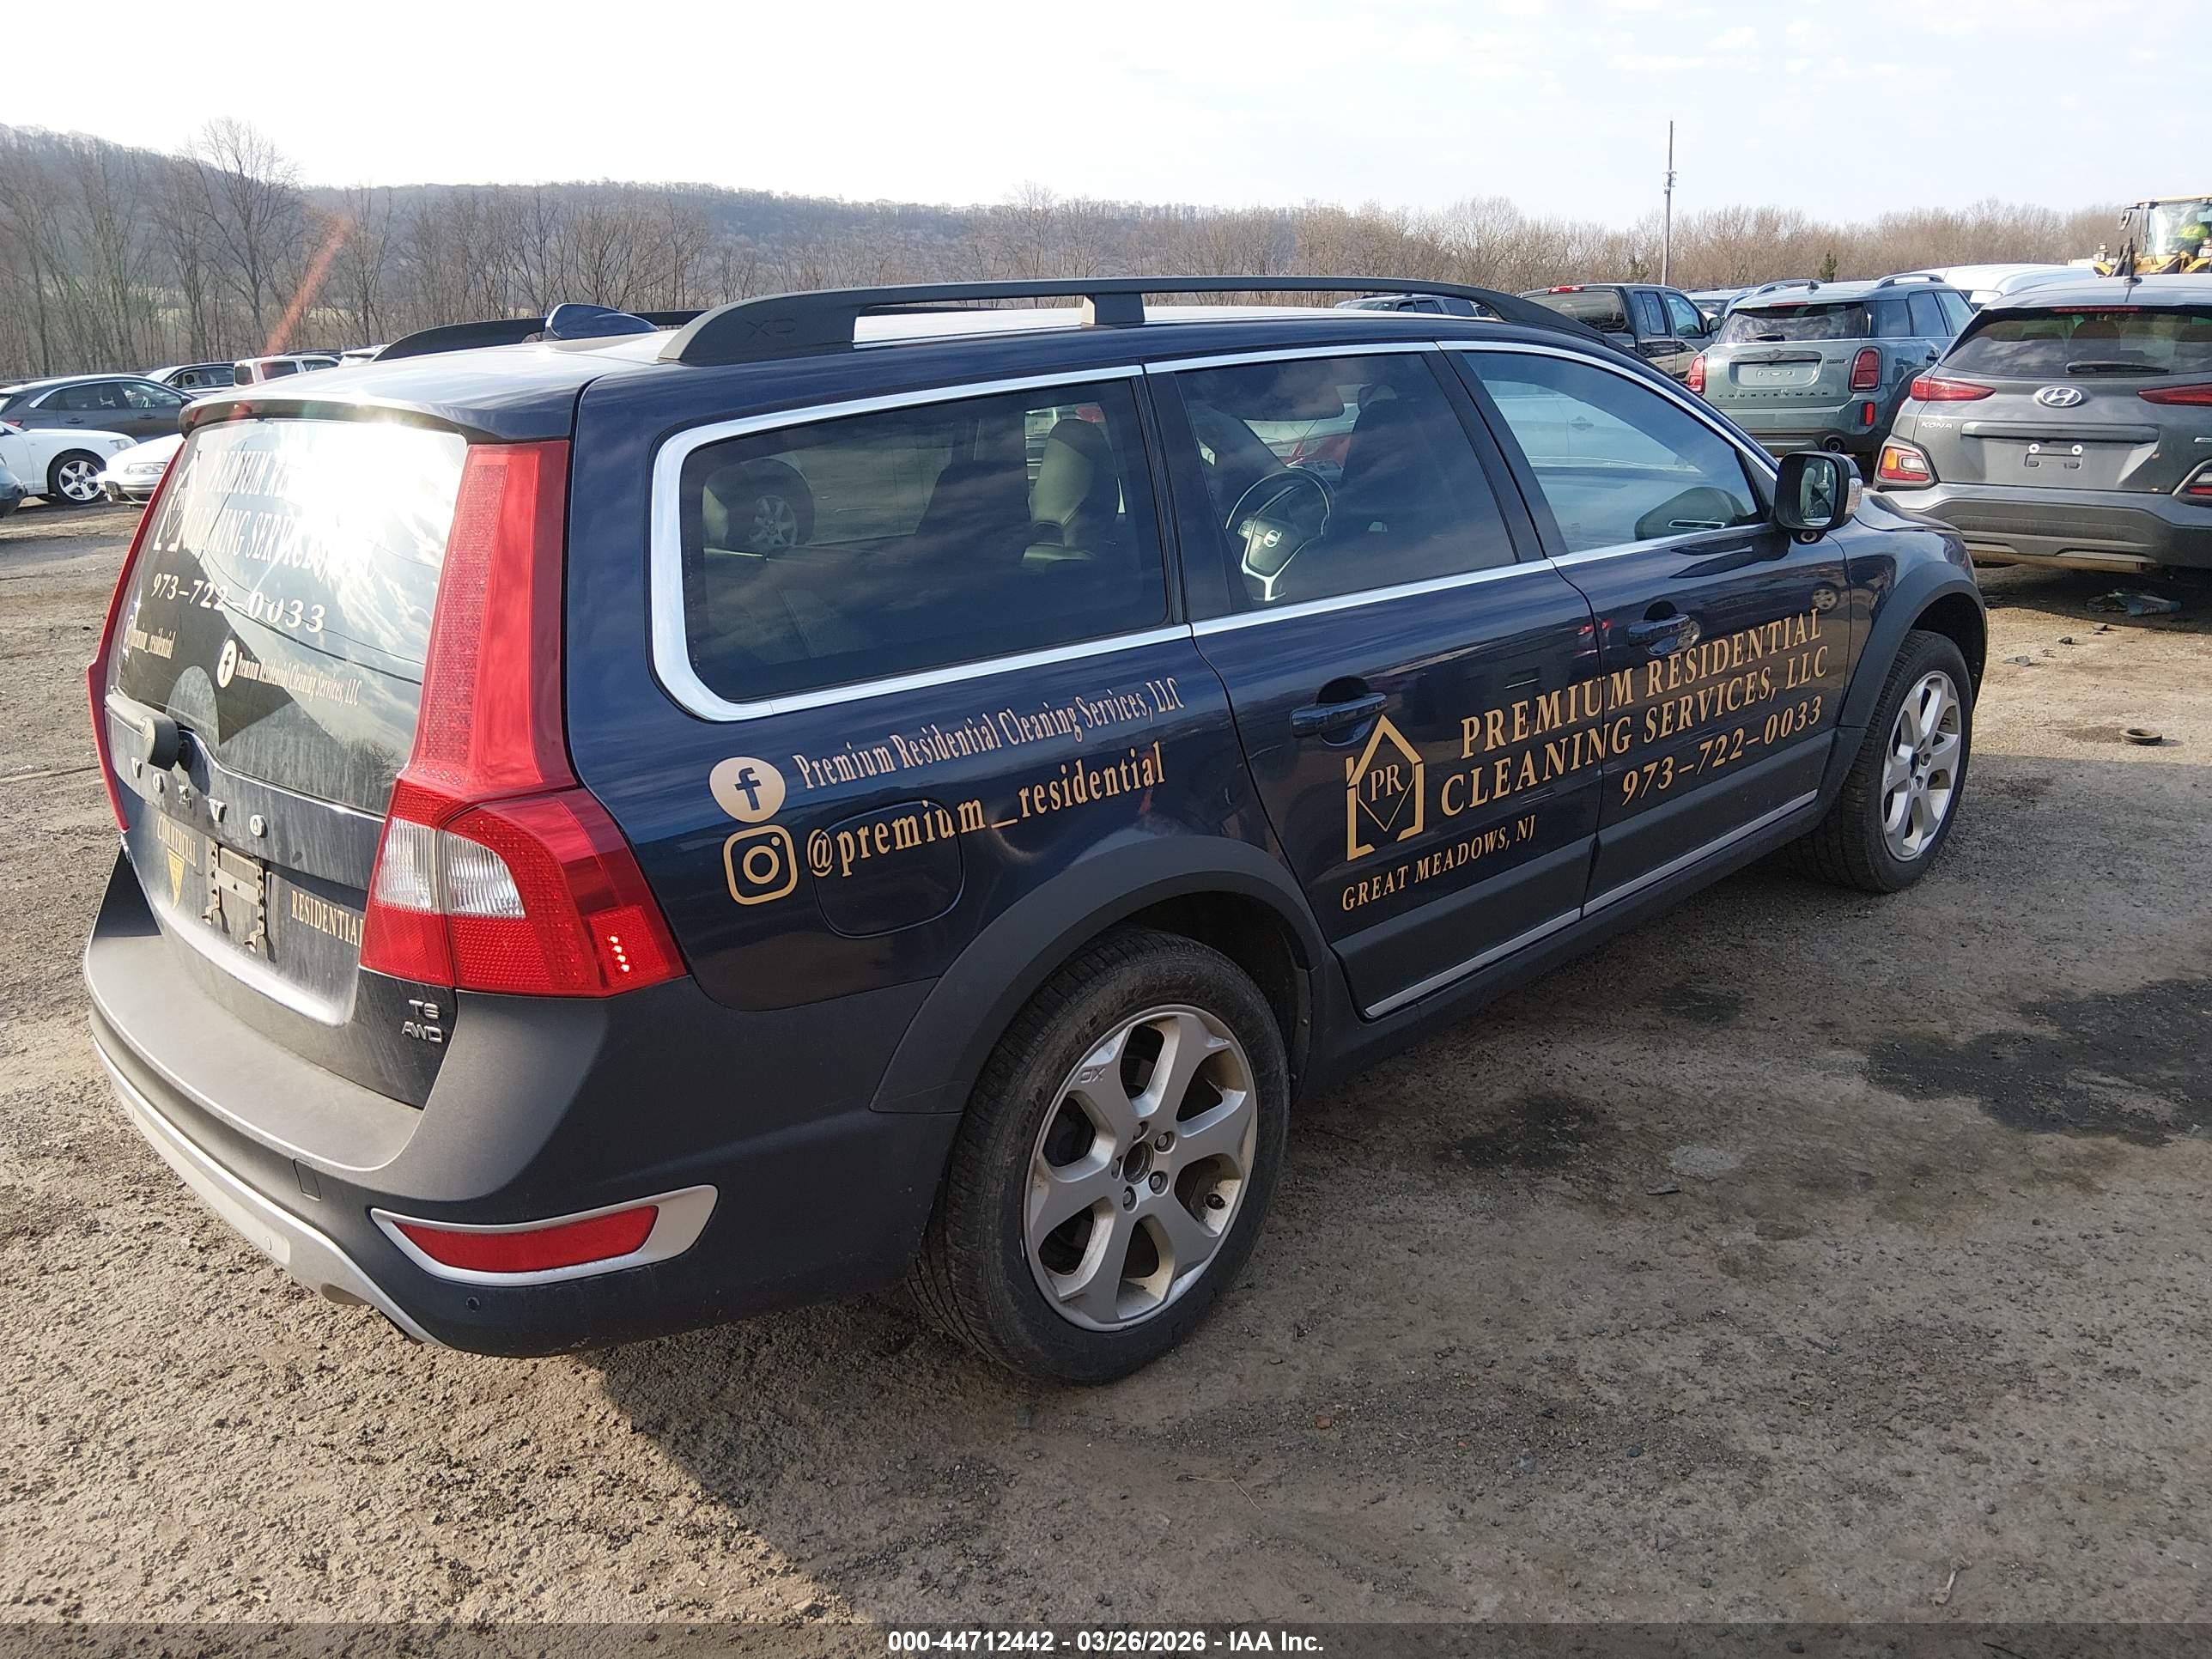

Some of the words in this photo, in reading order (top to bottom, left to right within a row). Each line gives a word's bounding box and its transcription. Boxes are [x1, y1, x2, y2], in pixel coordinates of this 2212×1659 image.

[1921, 421, 1953, 429] KONA
[149, 572, 326, 634] 973-722-0033
[235, 651, 260, 681] Premium
[258, 658, 291, 688] Residential
[289, 662, 318, 702] Cleaning
[345, 678, 362, 707] LLC
[1460, 667, 1635, 760] PREMIUM
[1646, 607, 1823, 697] RESIDENTIAL
[792, 741, 897, 790] Premium
[890, 715, 1002, 771] Residential
[1000, 700, 1083, 744] Cleaning
[1077, 687, 1155, 730] Services,
[1151, 677, 1185, 713] LLC
[1441, 717, 1633, 817] CLEANING
[1643, 667, 1778, 744] SERVICES,
[1785, 645, 1829, 690] LLC
[1621, 695, 1823, 806] 973-722-0033
[131, 757, 268, 839] VOLVO
[806, 740, 1166, 878] @premium_residential
[1370, 763, 1406, 803] PR
[157, 816, 198, 867] COMMERCIAL
[1341, 867, 1408, 913] GREAT
[1413, 828, 1513, 883] MEADOWS,
[1515, 813, 1538, 842] NJ
[401, 1021, 442, 1044] AWD
[408, 999, 440, 1020] T6
